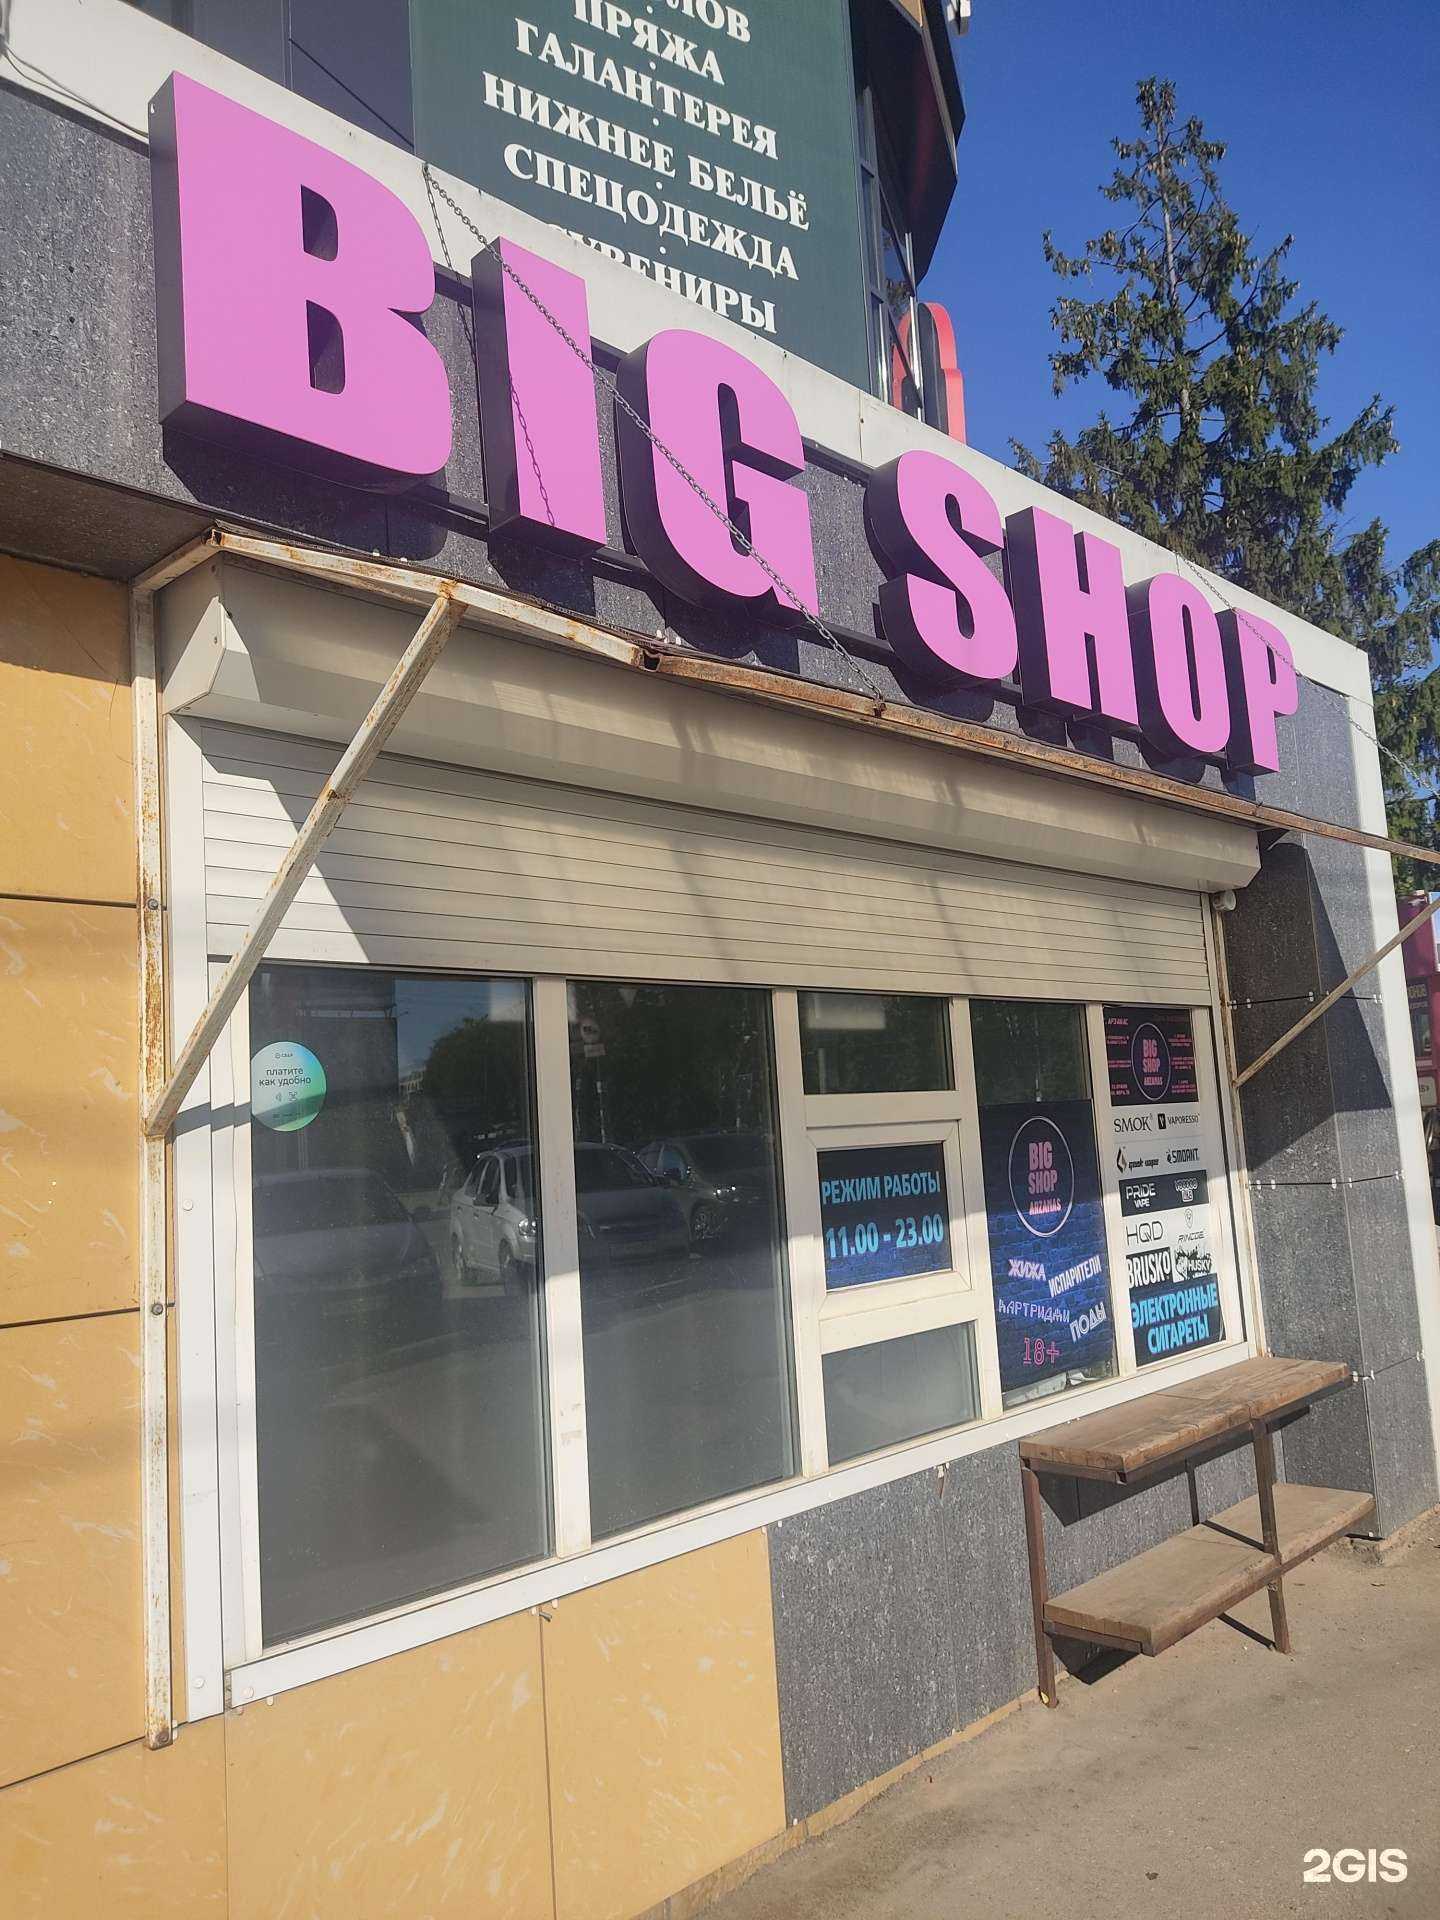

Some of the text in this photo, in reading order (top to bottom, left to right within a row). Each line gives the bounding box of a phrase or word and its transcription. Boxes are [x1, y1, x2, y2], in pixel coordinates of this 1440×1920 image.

[572, 0, 725, 86] ПРЯЖА
[514, 17, 779, 160] ГАЛАНТЕРЕЯ
[482, 71, 810, 231] НИЖНЕЕ БЕЛЬЁ
[503, 143, 800, 281] СПЕЦОДЕЖДА
[173, 70, 1299, 773] BIG SHOP
[1142, 1039, 1158, 1058] BIG
[266, 1067, 304, 1076] платите
[1142, 1057, 1161, 1073] SHOP
[259, 1075, 312, 1088] как удобно
[1113, 1115, 1152, 1133] SMOK
[1028, 1141, 1053, 1170] BIG
[821, 1170, 941, 1205] РЕЖИМ РАБОТЫ
[1028, 1169, 1058, 1195] SHOP
[1125, 1182, 1157, 1200] PRIDE
[1029, 1198, 1062, 1216] ARZAMAS
[825, 1222, 879, 1258] 11.00
[895, 1213, 944, 1248] 23.00
[1125, 1220, 1164, 1246] HQD
[1008, 1258, 1047, 1281] ЖИЖА
[1048, 1255, 1102, 1298] ИСПАРИТЕЛИ
[1127, 1251, 1170, 1289] BRUSKO
[1188, 1258, 1211, 1272] HUSKY
[998, 1299, 1071, 1324] КАРТРИДЖИ
[1130, 1283, 1219, 1329] ЭЛЕКТРОННЫЕ
[1069, 1301, 1107, 1343] ПОДЫ
[1147, 1314, 1210, 1355] СИГАРЕТЫ
[1023, 1337, 1061, 1366] 18+
